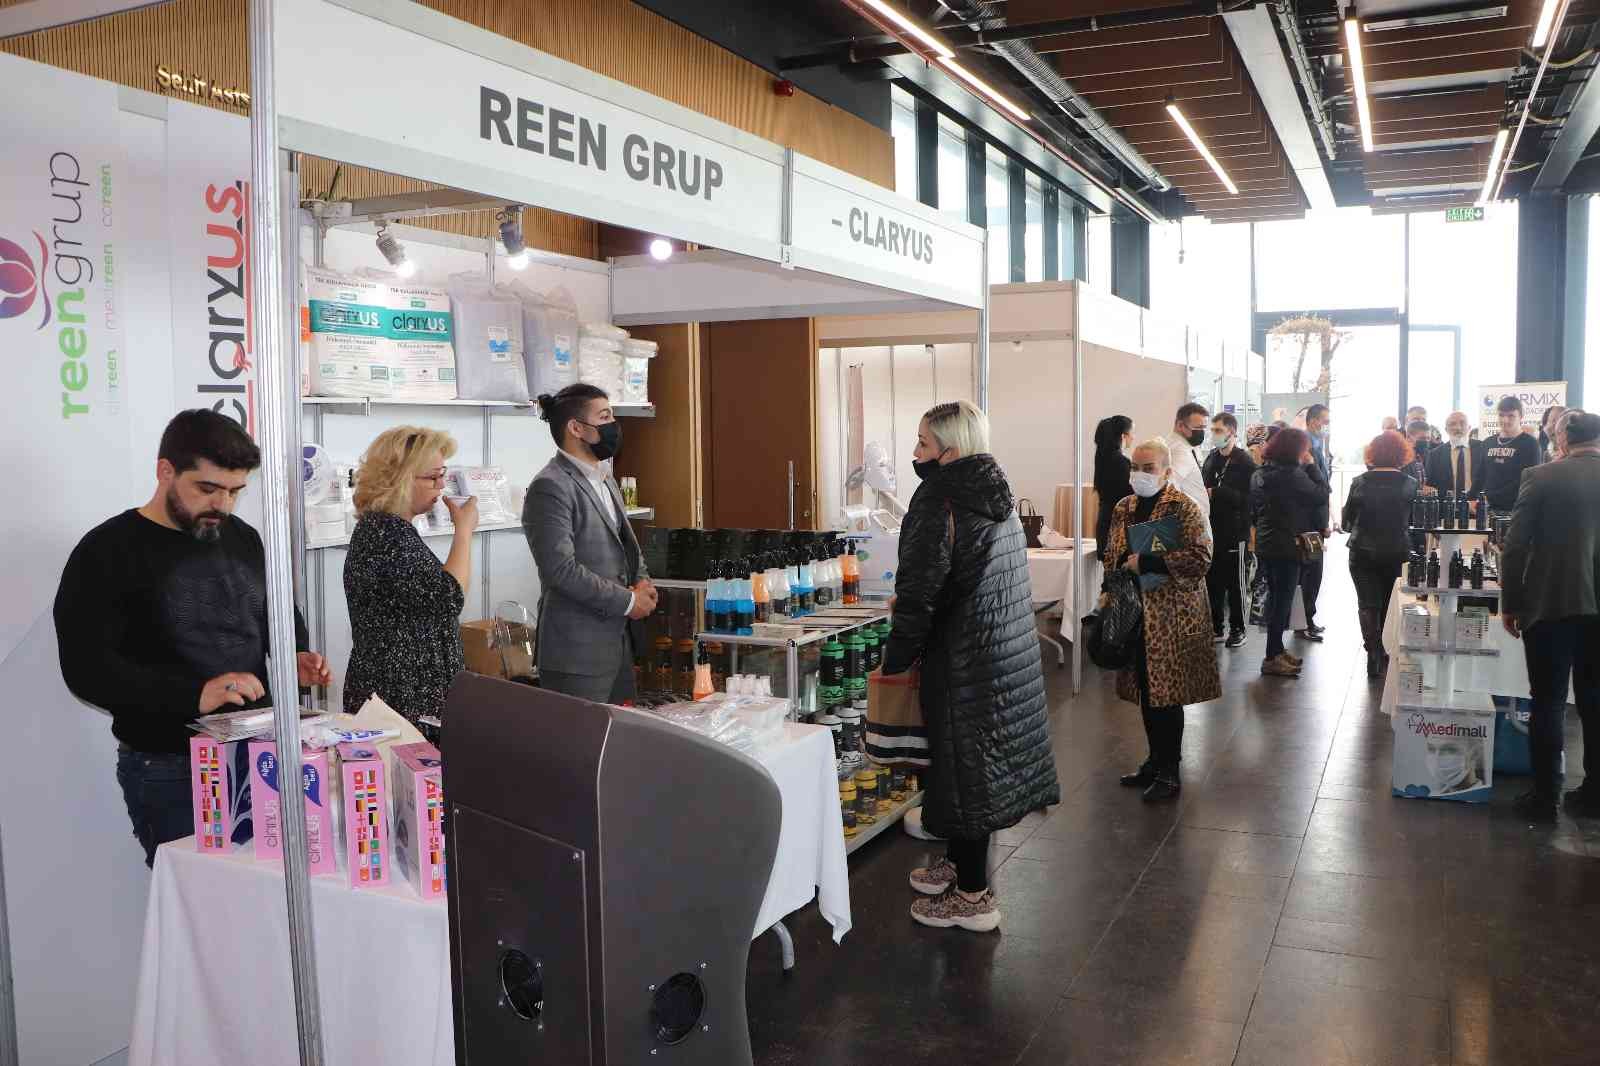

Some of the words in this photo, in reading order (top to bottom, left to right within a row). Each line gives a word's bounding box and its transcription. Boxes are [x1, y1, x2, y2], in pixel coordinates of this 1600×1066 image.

[480, 86, 607, 171] REEN
[623, 133, 723, 201] GRUP
[849, 207, 933, 264] CLARYUS
[1416, 719, 1488, 739] Medimall
